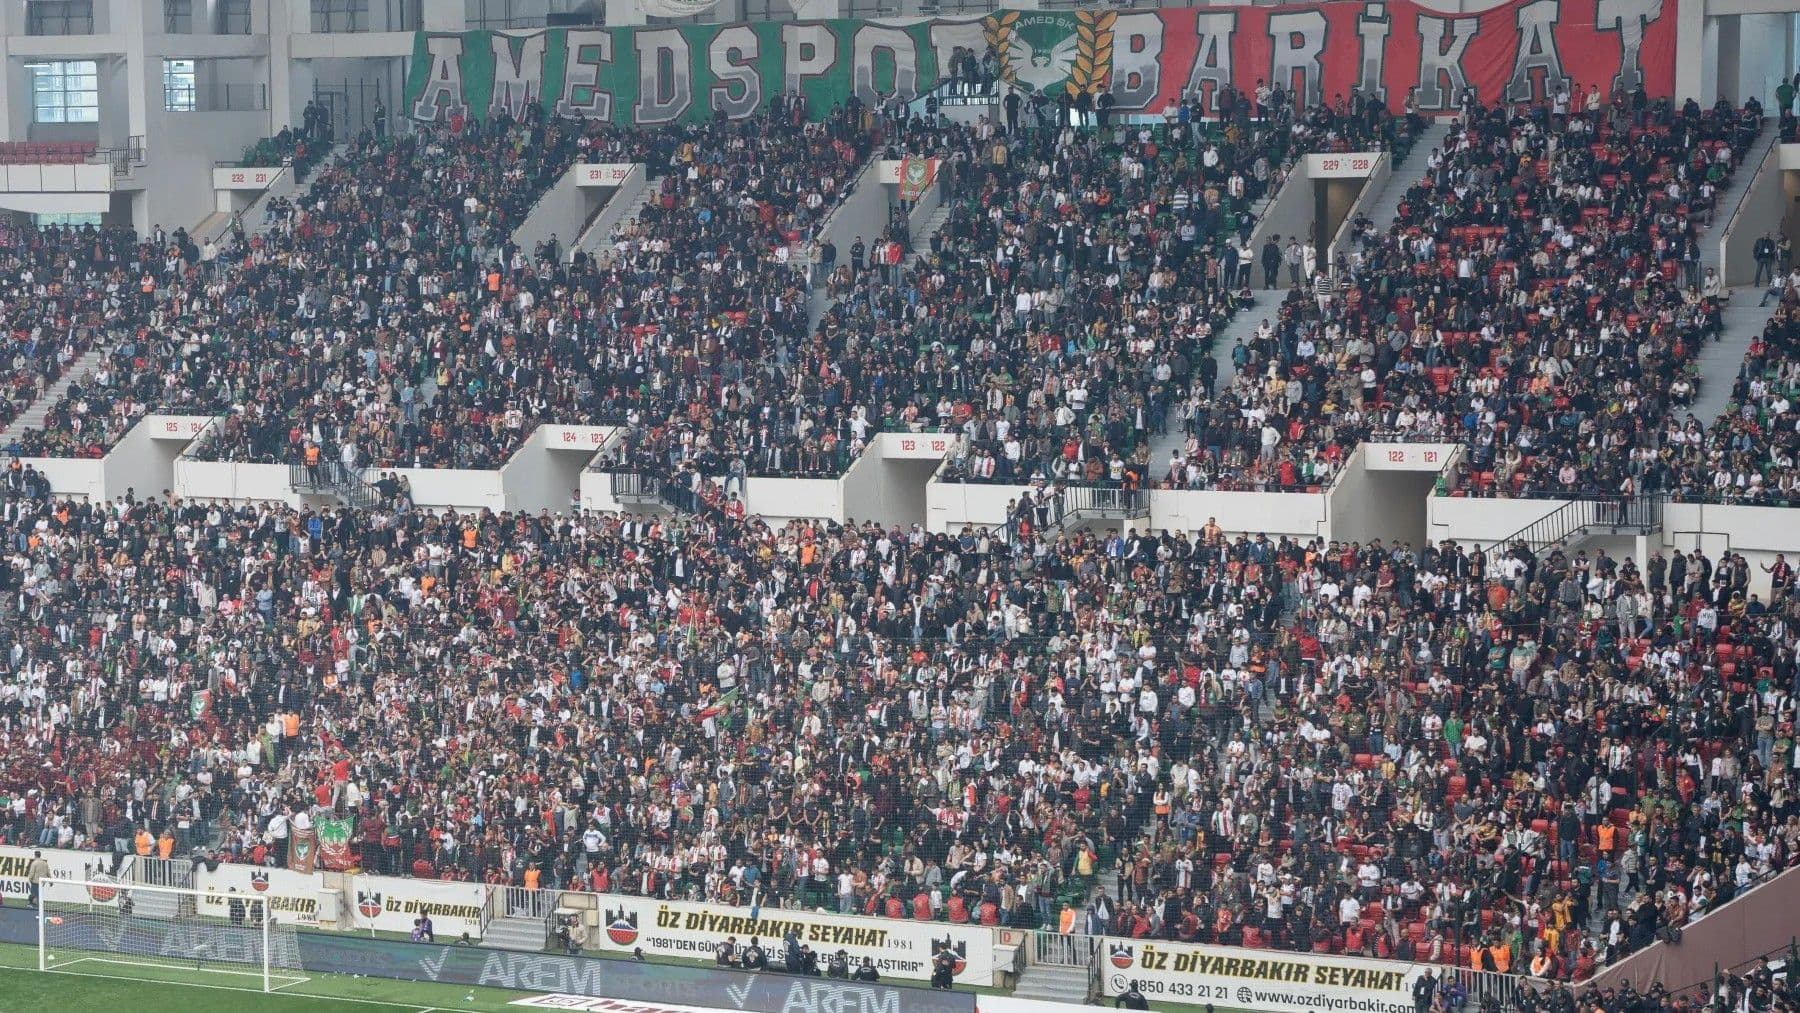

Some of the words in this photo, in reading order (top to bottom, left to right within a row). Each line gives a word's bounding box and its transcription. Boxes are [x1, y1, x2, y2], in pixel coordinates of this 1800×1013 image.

[1015, 15, 1055, 30] AMED
[1056, 17, 1075, 31] SK
[1323, 160, 1339, 171] 229
[1352, 159, 1369, 170] 228
[231, 173, 245, 183] 232
[255, 173, 267, 183] 231
[590, 170, 602, 179] 231
[612, 169, 626, 179] 230
[165, 422, 178, 432] 125
[563, 431, 577, 442] 124
[591, 433, 604, 443] 123
[901, 440, 915, 451] 123
[931, 440, 945, 451] 122
[1388, 450, 1404, 462] 122
[1423, 451, 1438, 463] 121
[385, 896, 401, 913] ÖZ
[404, 899, 481, 918] DİYARBAKIR
[657, 905, 681, 928] ÖZ
[685, 910, 805, 939] DİYARBAKIR
[808, 923, 888, 947] SEYAHAT
[887, 938, 913, 950] 1981
[1002, 931, 1011, 943] D
[1141, 945, 1169, 970] ÖZ
[1173, 951, 1310, 983] DİYARBAKIR
[1314, 965, 1405, 991] SEYAHAT
[1168, 982, 1193, 996] 433
[1197, 984, 1211, 997] 21
[1215, 986, 1228, 999] 21
